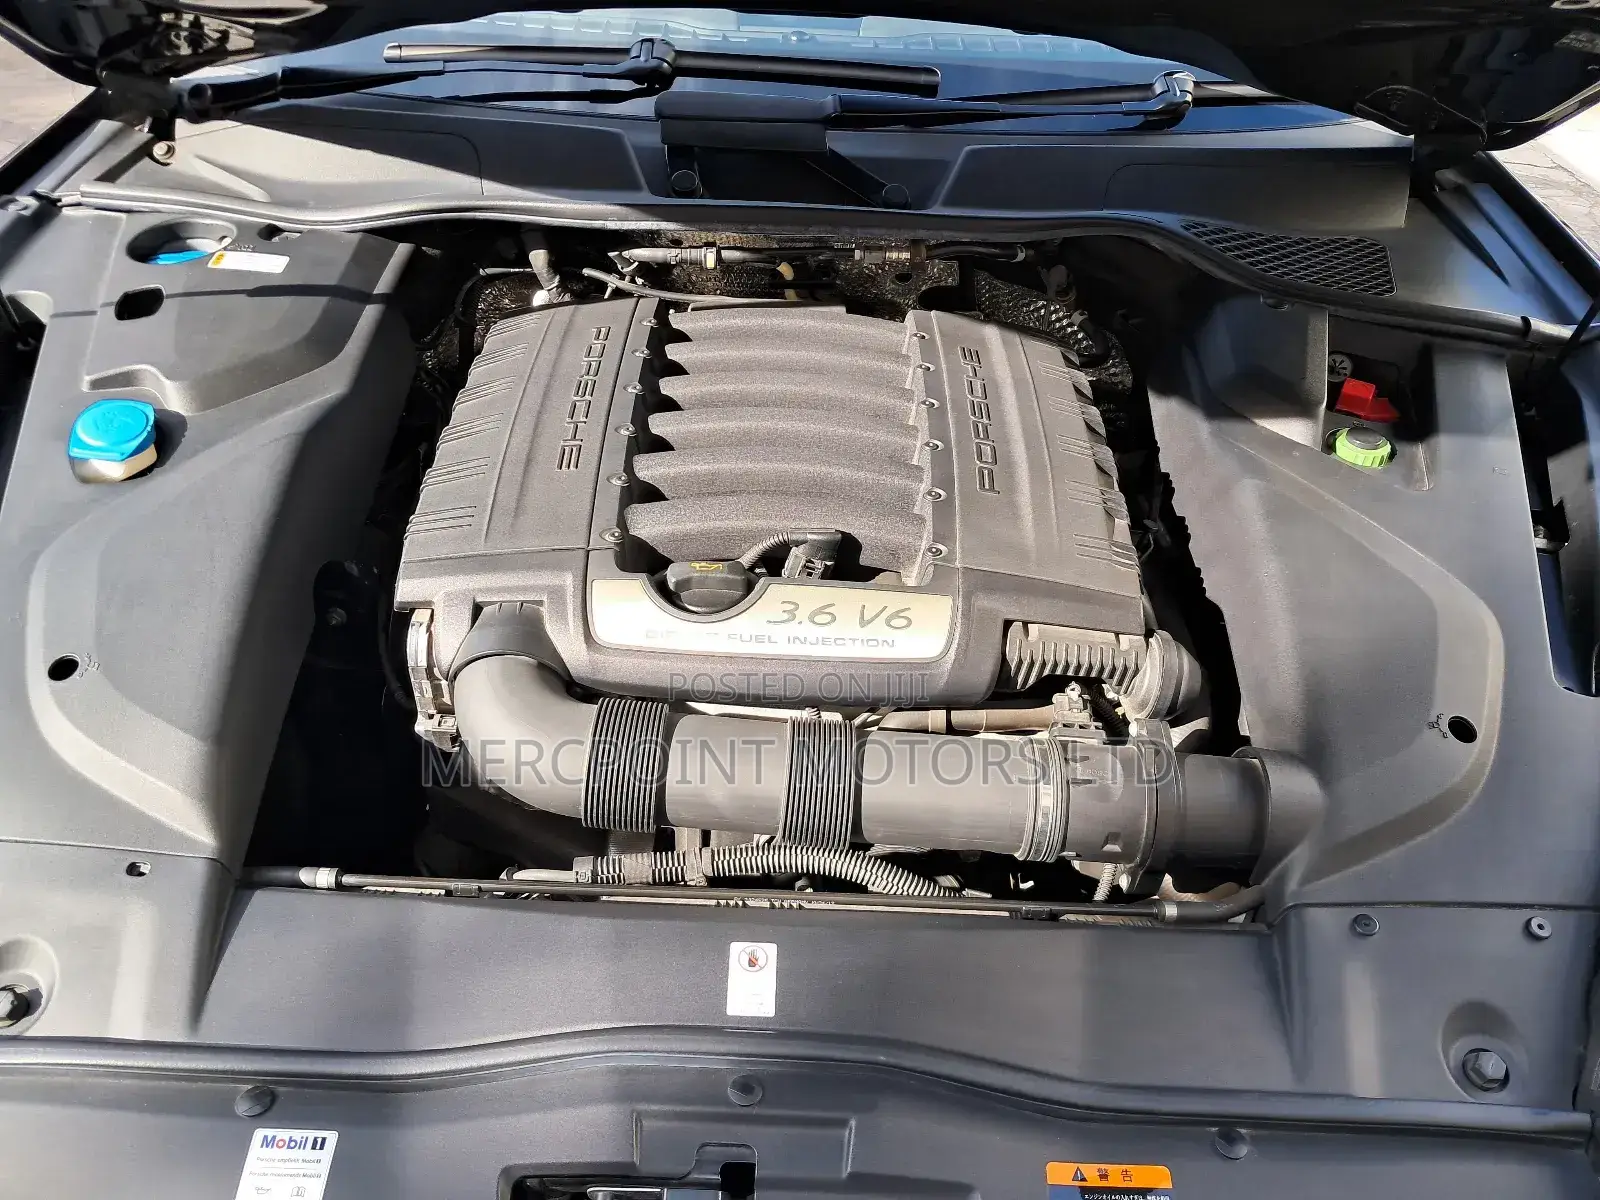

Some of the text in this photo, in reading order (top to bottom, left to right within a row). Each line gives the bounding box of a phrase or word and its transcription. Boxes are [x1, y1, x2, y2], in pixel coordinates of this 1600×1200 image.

[556, 326, 611, 471] PORSCHE
[957, 345, 1000, 495] PORSCHE
[766, 600, 913, 630] 3.6 V6
[728, 633, 778, 645] FUEL
[787, 635, 896, 648] INJECTION
[260, 1134, 327, 1151] Mobil 1
[1097, 1167, 1134, 1183] 警告
